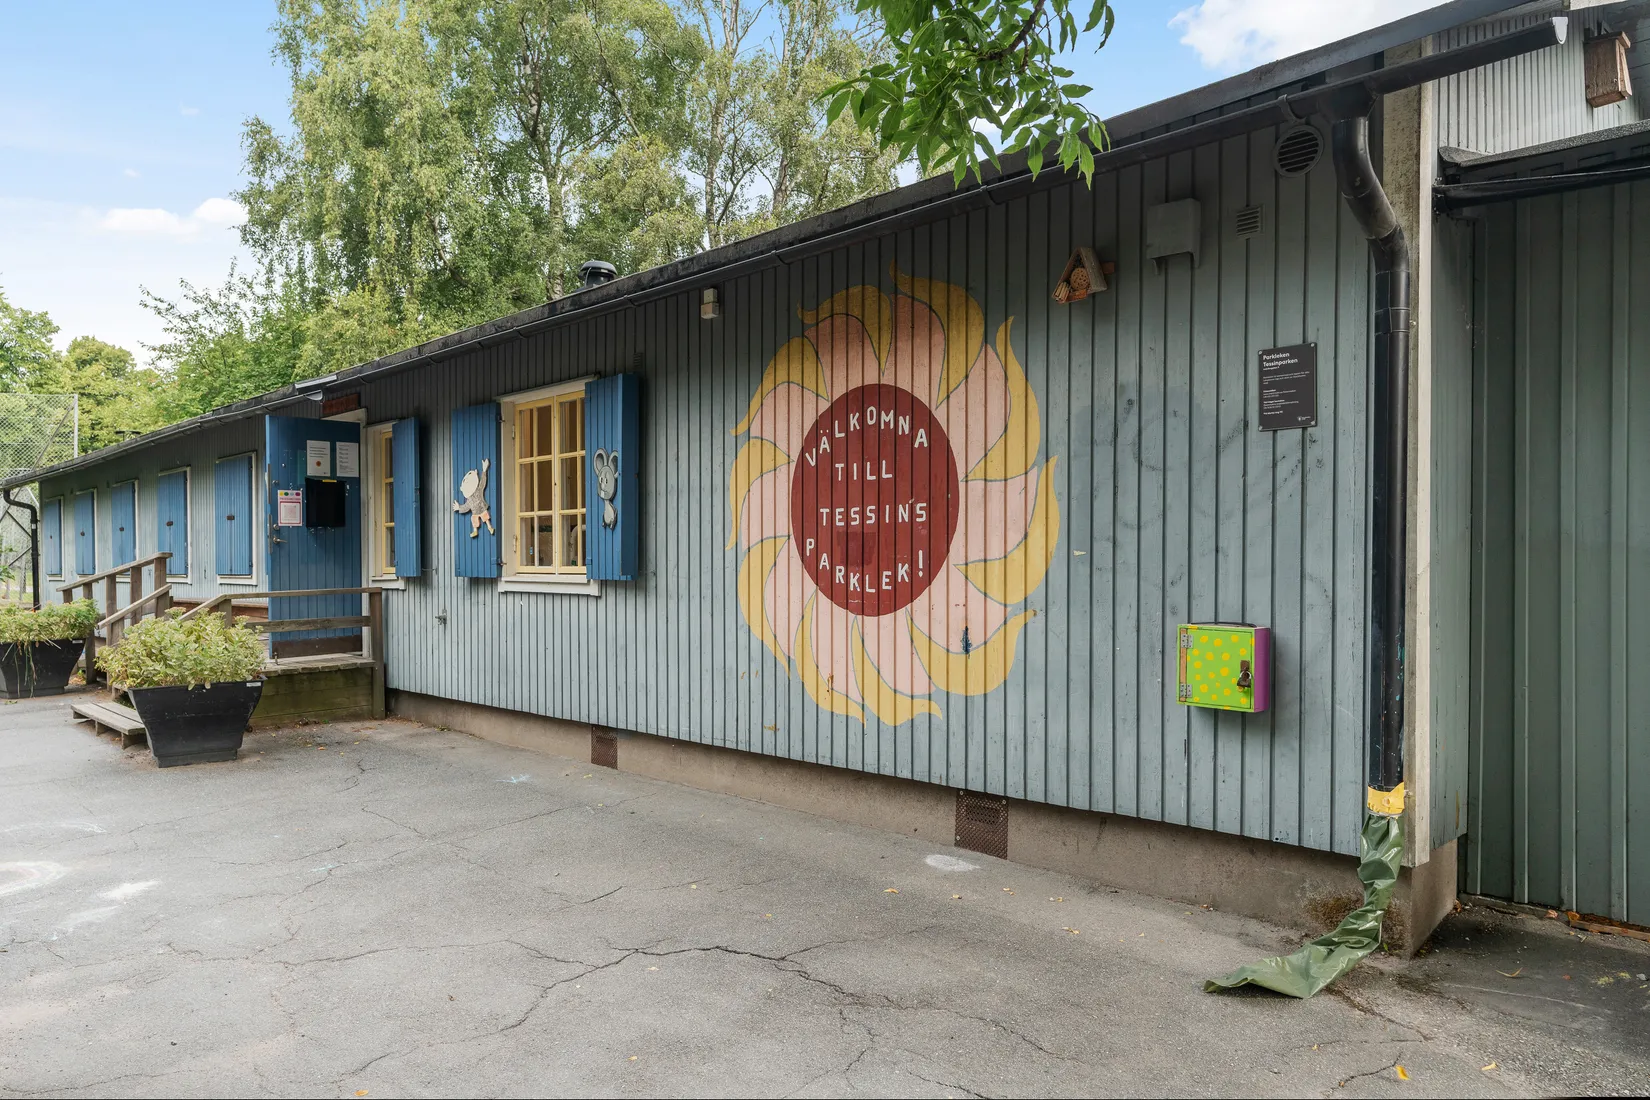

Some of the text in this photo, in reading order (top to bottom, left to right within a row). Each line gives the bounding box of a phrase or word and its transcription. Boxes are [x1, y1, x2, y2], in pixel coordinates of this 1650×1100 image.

[1263, 352, 1290, 360] Parkleken
[1263, 358, 1298, 367] Tessinparken
[805, 405, 928, 467] VÄLKOMNA
[835, 459, 893, 481] TILL
[819, 502, 927, 526] TESSINS
[805, 537, 924, 593] PARKLEK!
